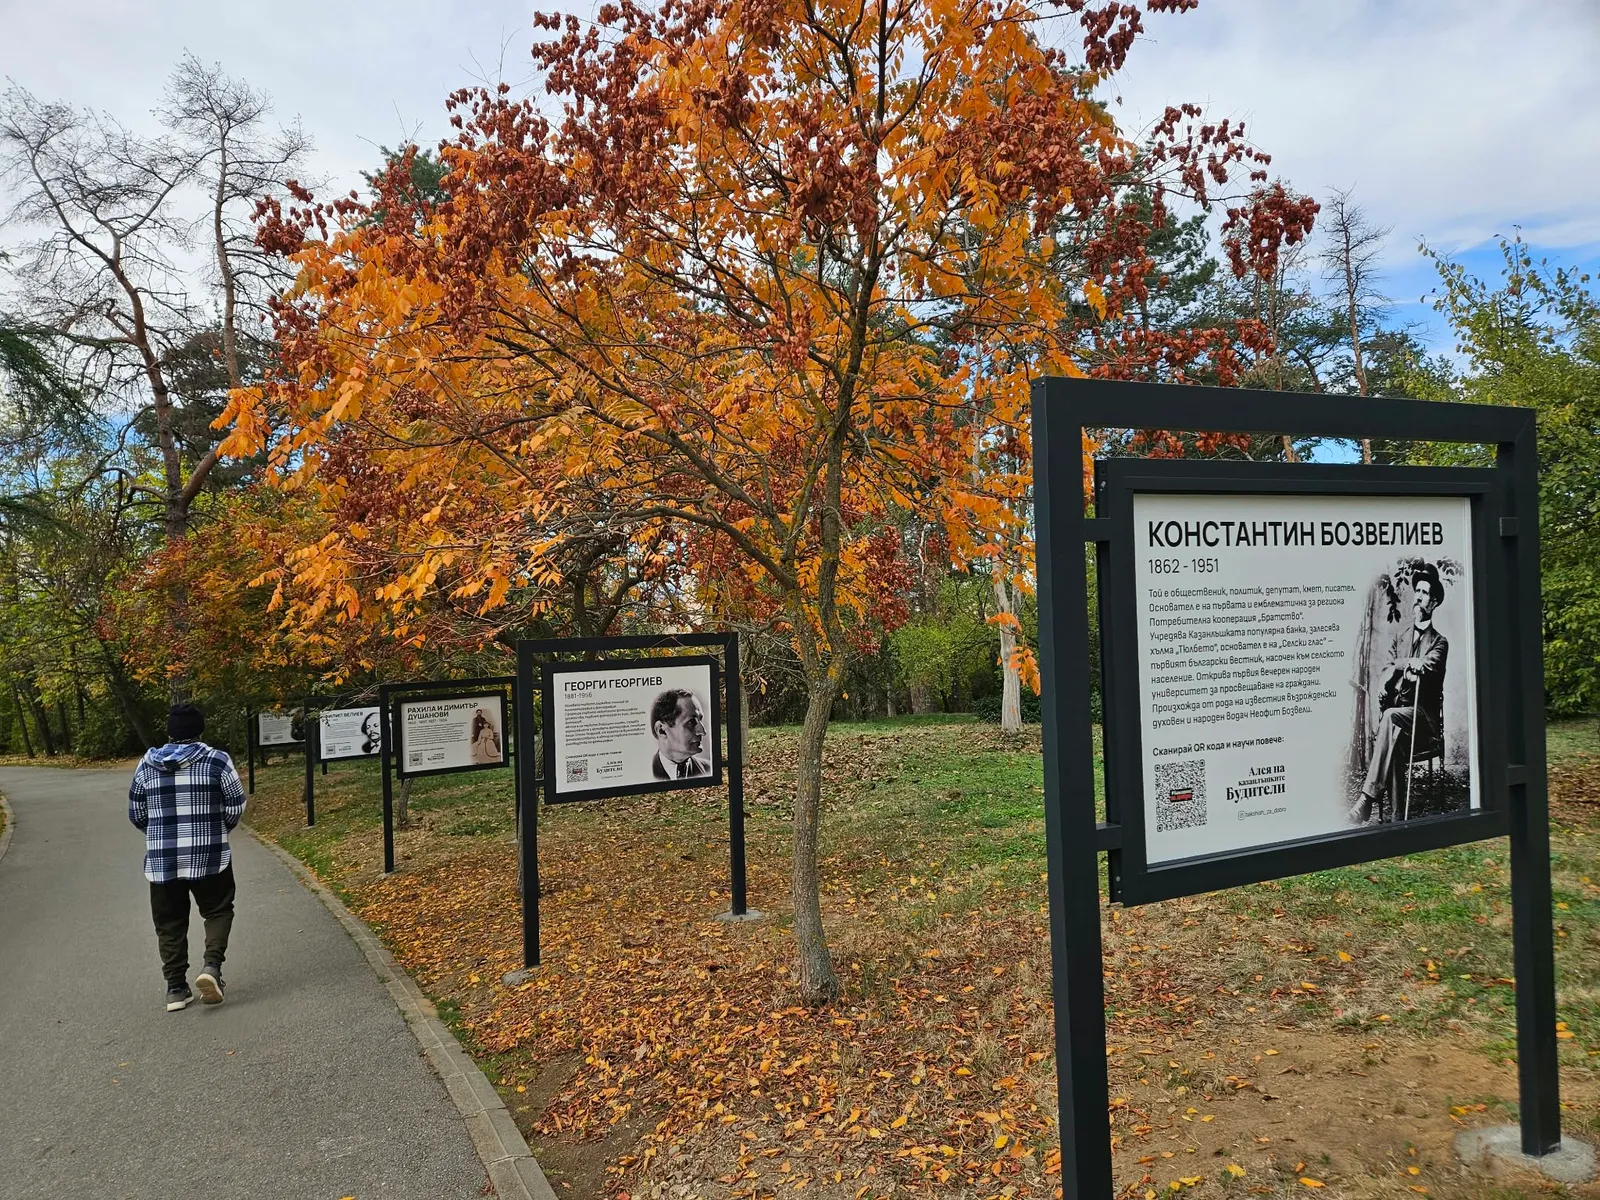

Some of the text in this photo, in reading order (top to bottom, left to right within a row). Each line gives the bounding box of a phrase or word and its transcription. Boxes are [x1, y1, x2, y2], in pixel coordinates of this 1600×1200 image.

[1148, 520, 1445, 548] КОНСТАНТИН БОЗВЕЛИЕВ
[1148, 559, 1180, 574] 1862
[1191, 558, 1220, 573] 1951
[1147, 588, 1162, 597] Той
[1170, 586, 1228, 597] общественик,
[1229, 585, 1264, 595] политик,
[1265, 586, 1301, 596] депутат,
[1302, 584, 1324, 593] кмет,
[1324, 584, 1355, 592] писател.
[1148, 601, 1194, 612] Основател
[1201, 602, 1211, 610] на
[1212, 600, 1246, 611] първата
[1253, 599, 1307, 608] емблематична
[1307, 599, 1316, 608] за
[1316, 598, 1344, 607] региона
[1149, 615, 1211, 628] Потребителна
[1212, 614, 1256, 624] кооперация
[1149, 623, 1339, 642] Учредява Казанлъшката популярна банка, залесява
[1149, 646, 1174, 655] хълма
[1220, 641, 1261, 651] основател
[1150, 650, 1344, 671] първият български вестник, насочен към селското
[1150, 665, 1320, 684] население. Открива първия вечерен народен
[564, 676, 663, 692] ГЕОРГИ ГЕОРГИЕВ
[1151, 687, 1208, 700] университет
[1209, 686, 1218, 696] за
[1219, 681, 1274, 694] просвещаване
[1284, 678, 1320, 689] граждани.
[407, 705, 437, 714] РАХИЛА
[443, 702, 479, 712] ДИМИТЪР
[1151, 700, 1200, 714] Произхожда
[1201, 700, 1214, 708] от
[1214, 699, 1233, 709] рода
[1244, 694, 1285, 706] известния
[1286, 689, 1336, 702] възрожденски
[407, 711, 449, 721] ДУШАНОВИ
[1152, 705, 1312, 729] духовен и народен водач Неофит Бозвели.
[1152, 743, 1193, 757] Сканирай
[1193, 742, 1206, 752] QR
[1206, 742, 1225, 752] кода
[1231, 739, 1255, 750] научи
[1255, 736, 1285, 746] повече:
[1273, 765, 1285, 774] на
[1226, 783, 1286, 803] Будители
